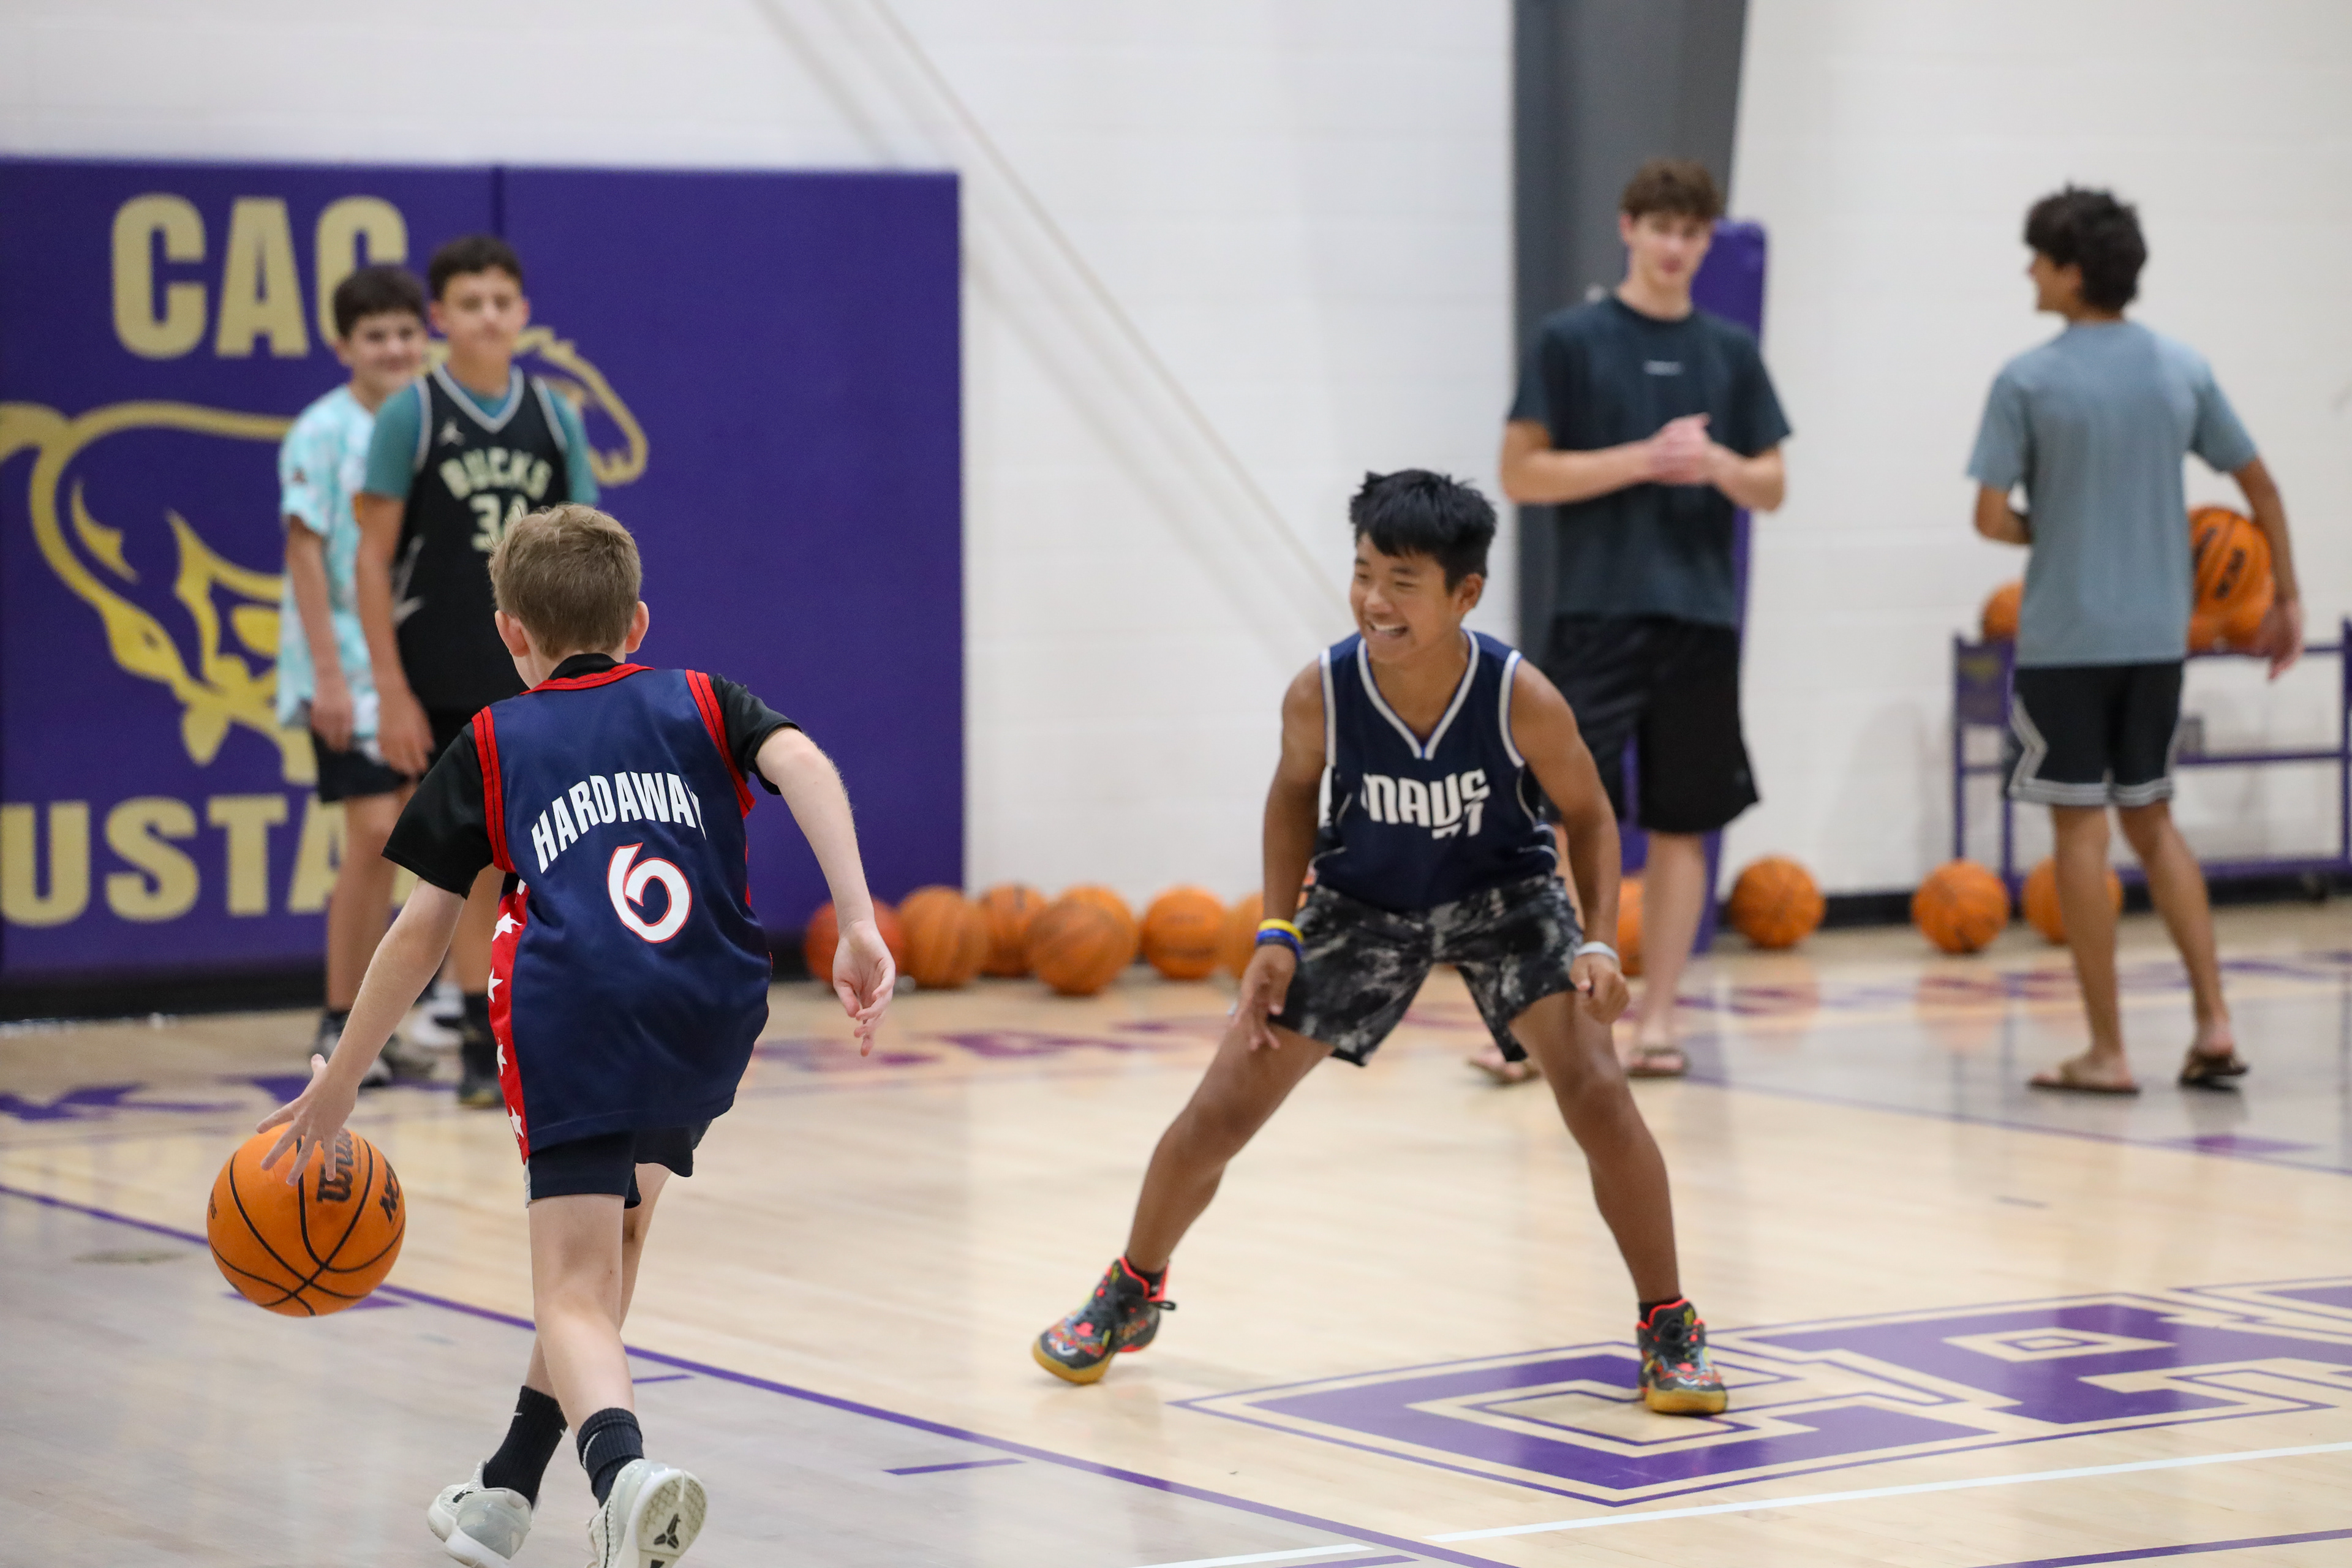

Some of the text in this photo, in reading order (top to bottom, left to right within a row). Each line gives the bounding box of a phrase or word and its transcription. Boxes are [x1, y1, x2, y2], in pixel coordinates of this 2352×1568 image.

[111, 193, 409, 360] CAC
[438, 447, 552, 501] BUCKS
[606, 842, 692, 943] 6
